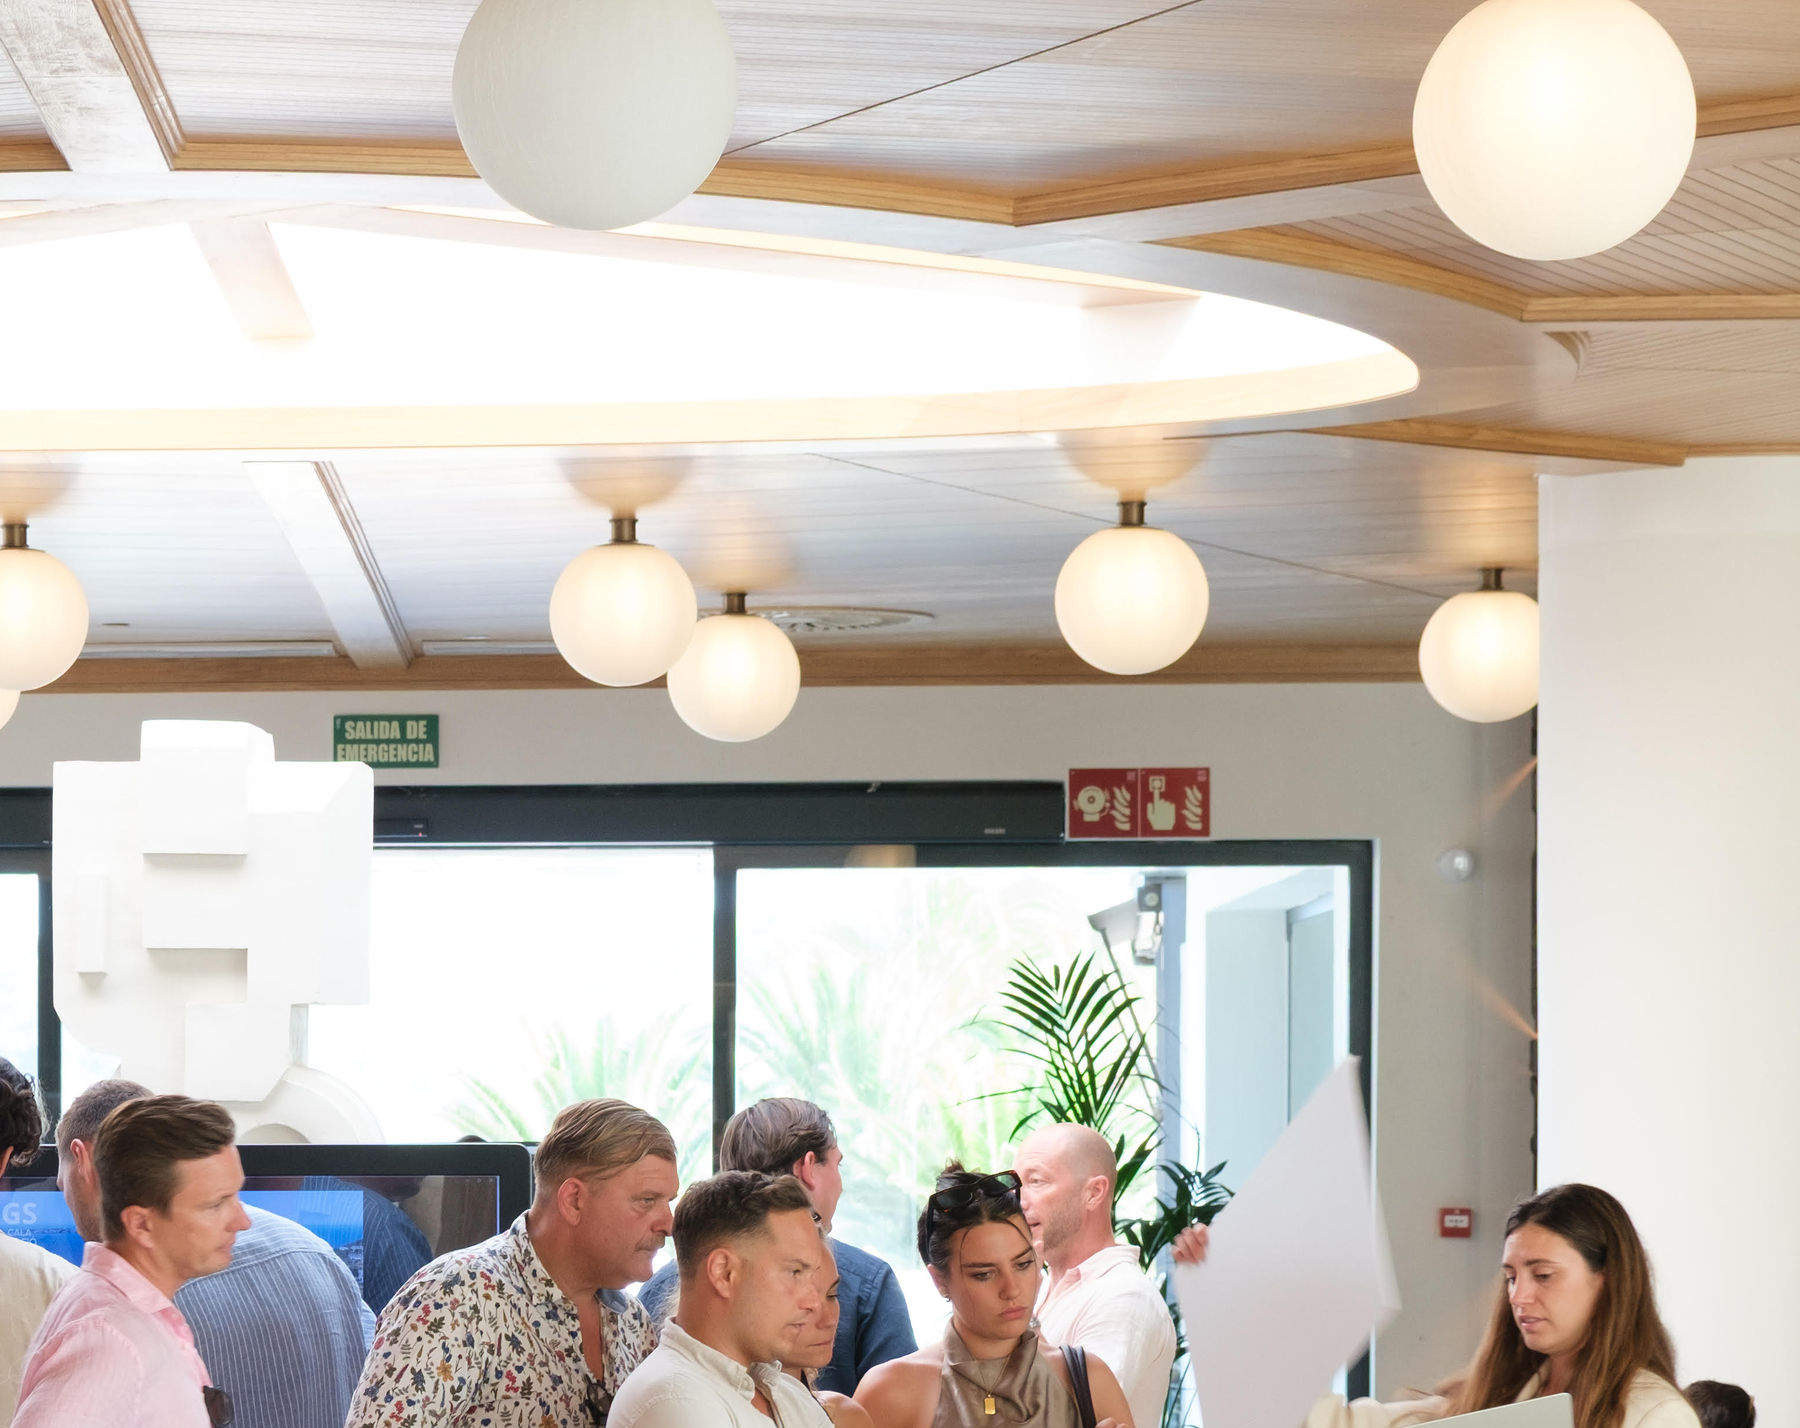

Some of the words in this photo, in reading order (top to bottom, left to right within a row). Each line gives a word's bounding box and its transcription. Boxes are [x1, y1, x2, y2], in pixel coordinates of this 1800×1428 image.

[345, 720, 401, 740] SALIDA
[406, 720, 428, 739] DE
[336, 743, 435, 762] EMERGENCIA
[2, 1201, 38, 1225] GS
